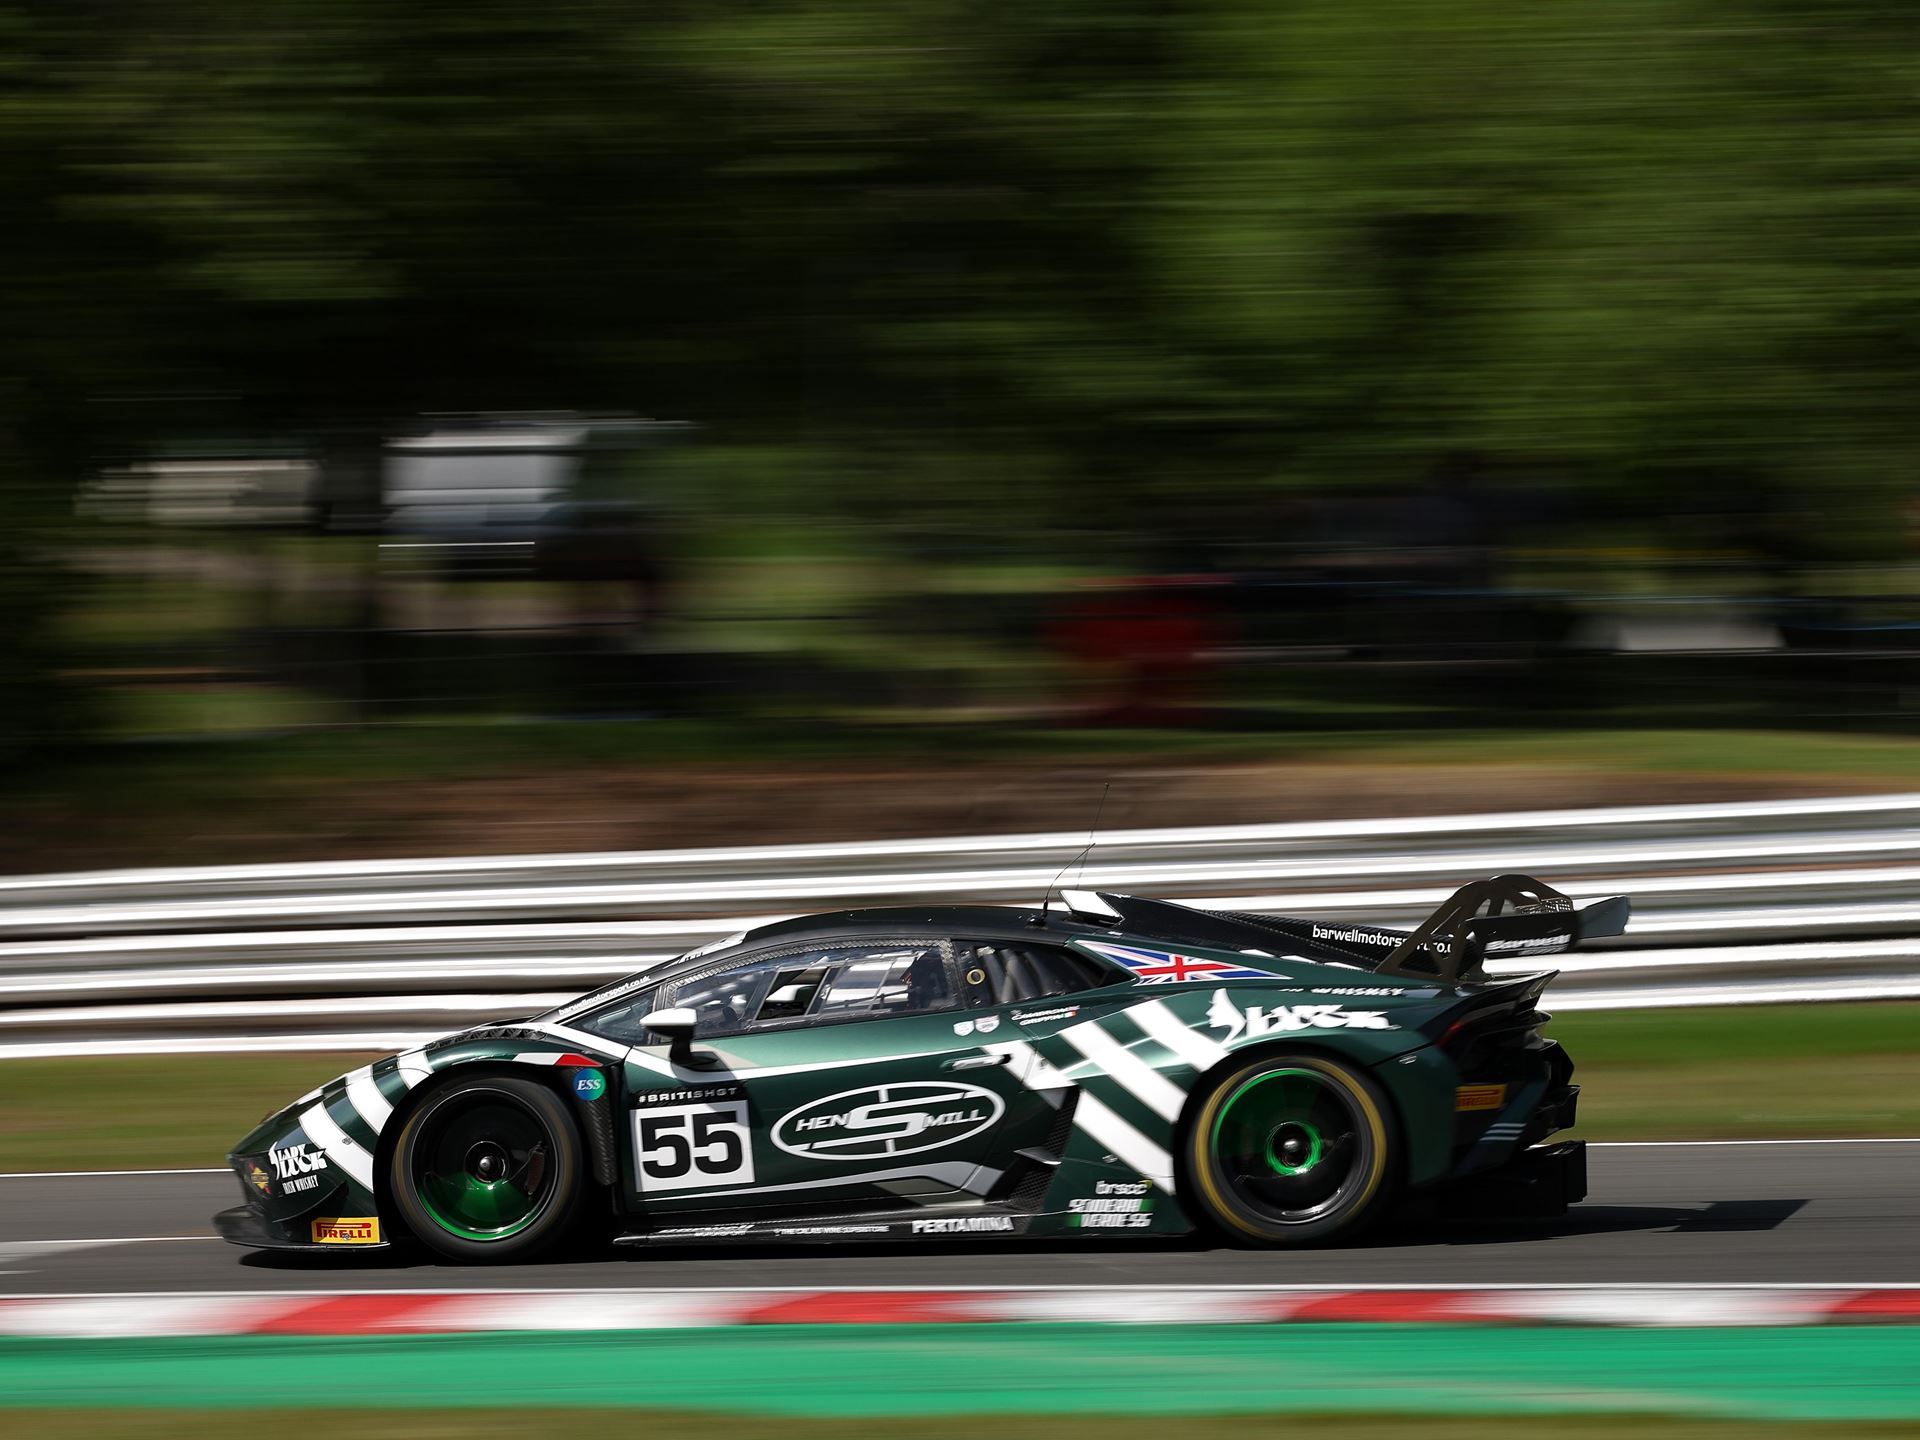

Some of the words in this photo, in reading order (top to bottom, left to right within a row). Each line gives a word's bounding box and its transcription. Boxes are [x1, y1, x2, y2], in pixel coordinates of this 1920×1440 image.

[558, 975, 651, 1016] barwellmotorsport.co.uk
[577, 1078, 601, 1092] ESS
[639, 1087, 737, 1104] #BRITISHGT
[277, 1143, 306, 1160] LADY
[640, 1110, 743, 1179] 55
[280, 1149, 328, 1179] LUCK
[294, 1175, 319, 1192] WHISKEY
[315, 1222, 372, 1239] PIRELLI
[911, 1217, 1015, 1234] PERTAMINA
